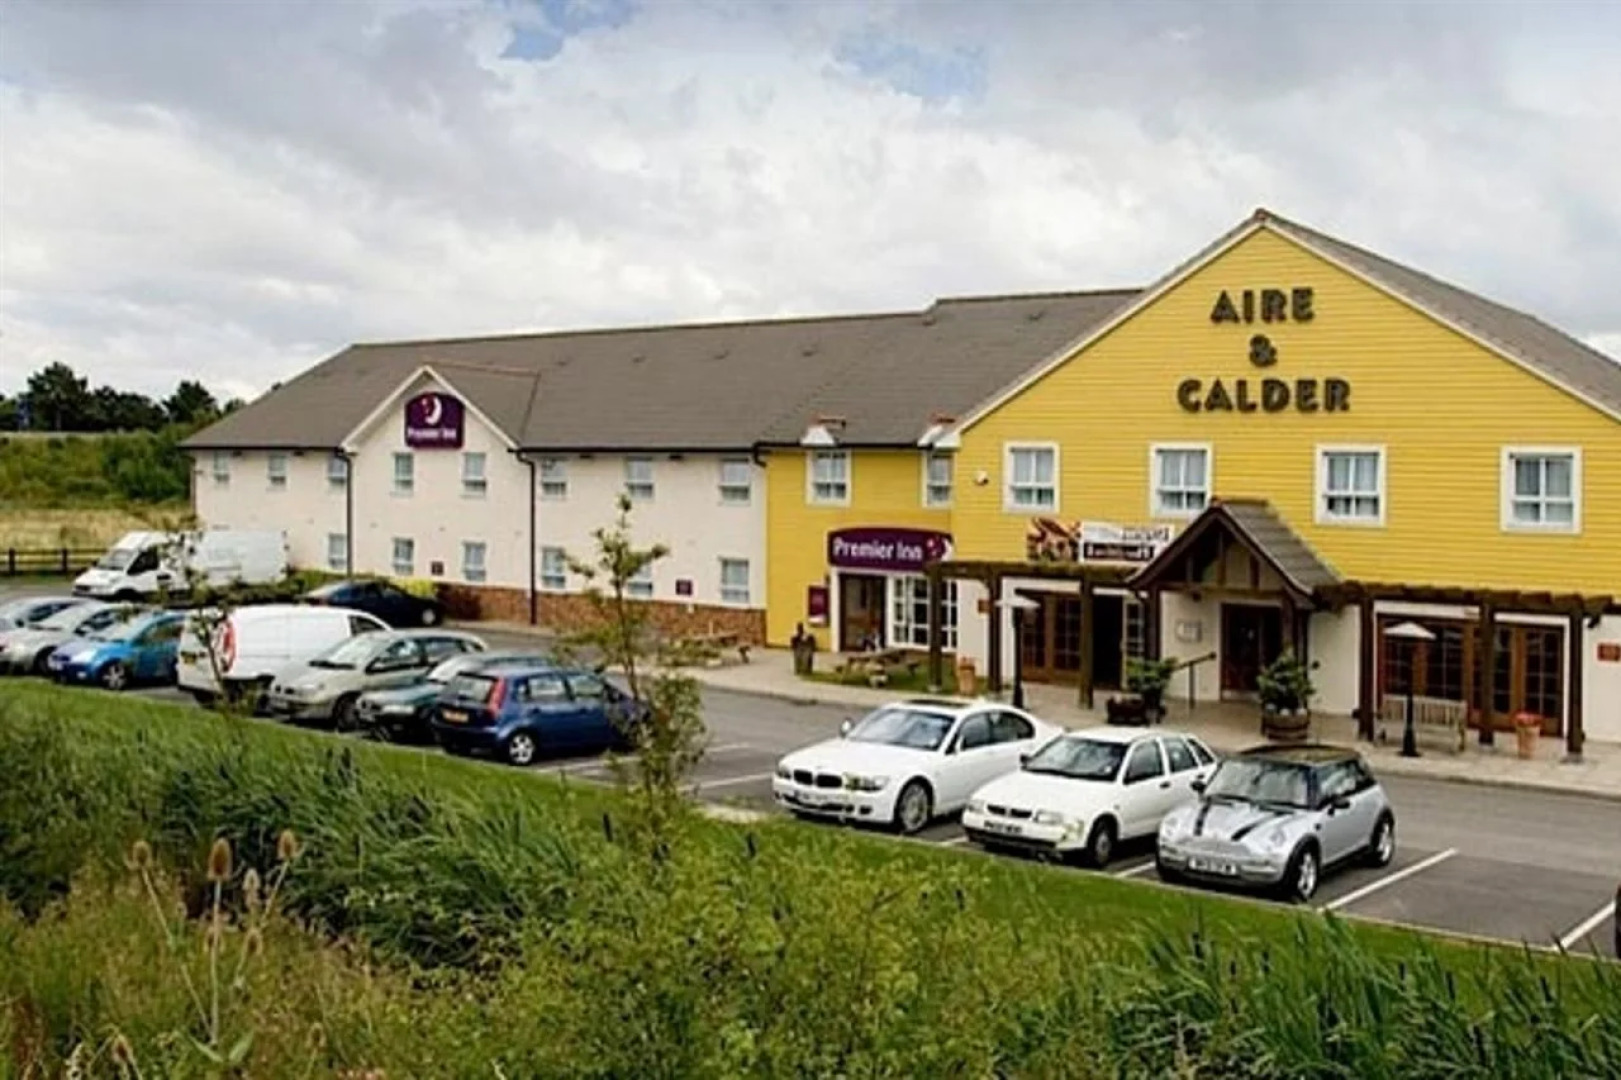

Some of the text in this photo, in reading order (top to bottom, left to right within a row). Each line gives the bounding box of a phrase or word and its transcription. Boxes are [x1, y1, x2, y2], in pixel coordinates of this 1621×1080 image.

[1210, 286, 1315, 325] AIRE
[1249, 334, 1278, 368] &
[1177, 378, 1351, 413] CALDER
[832, 536, 923, 561] Premier Inn
